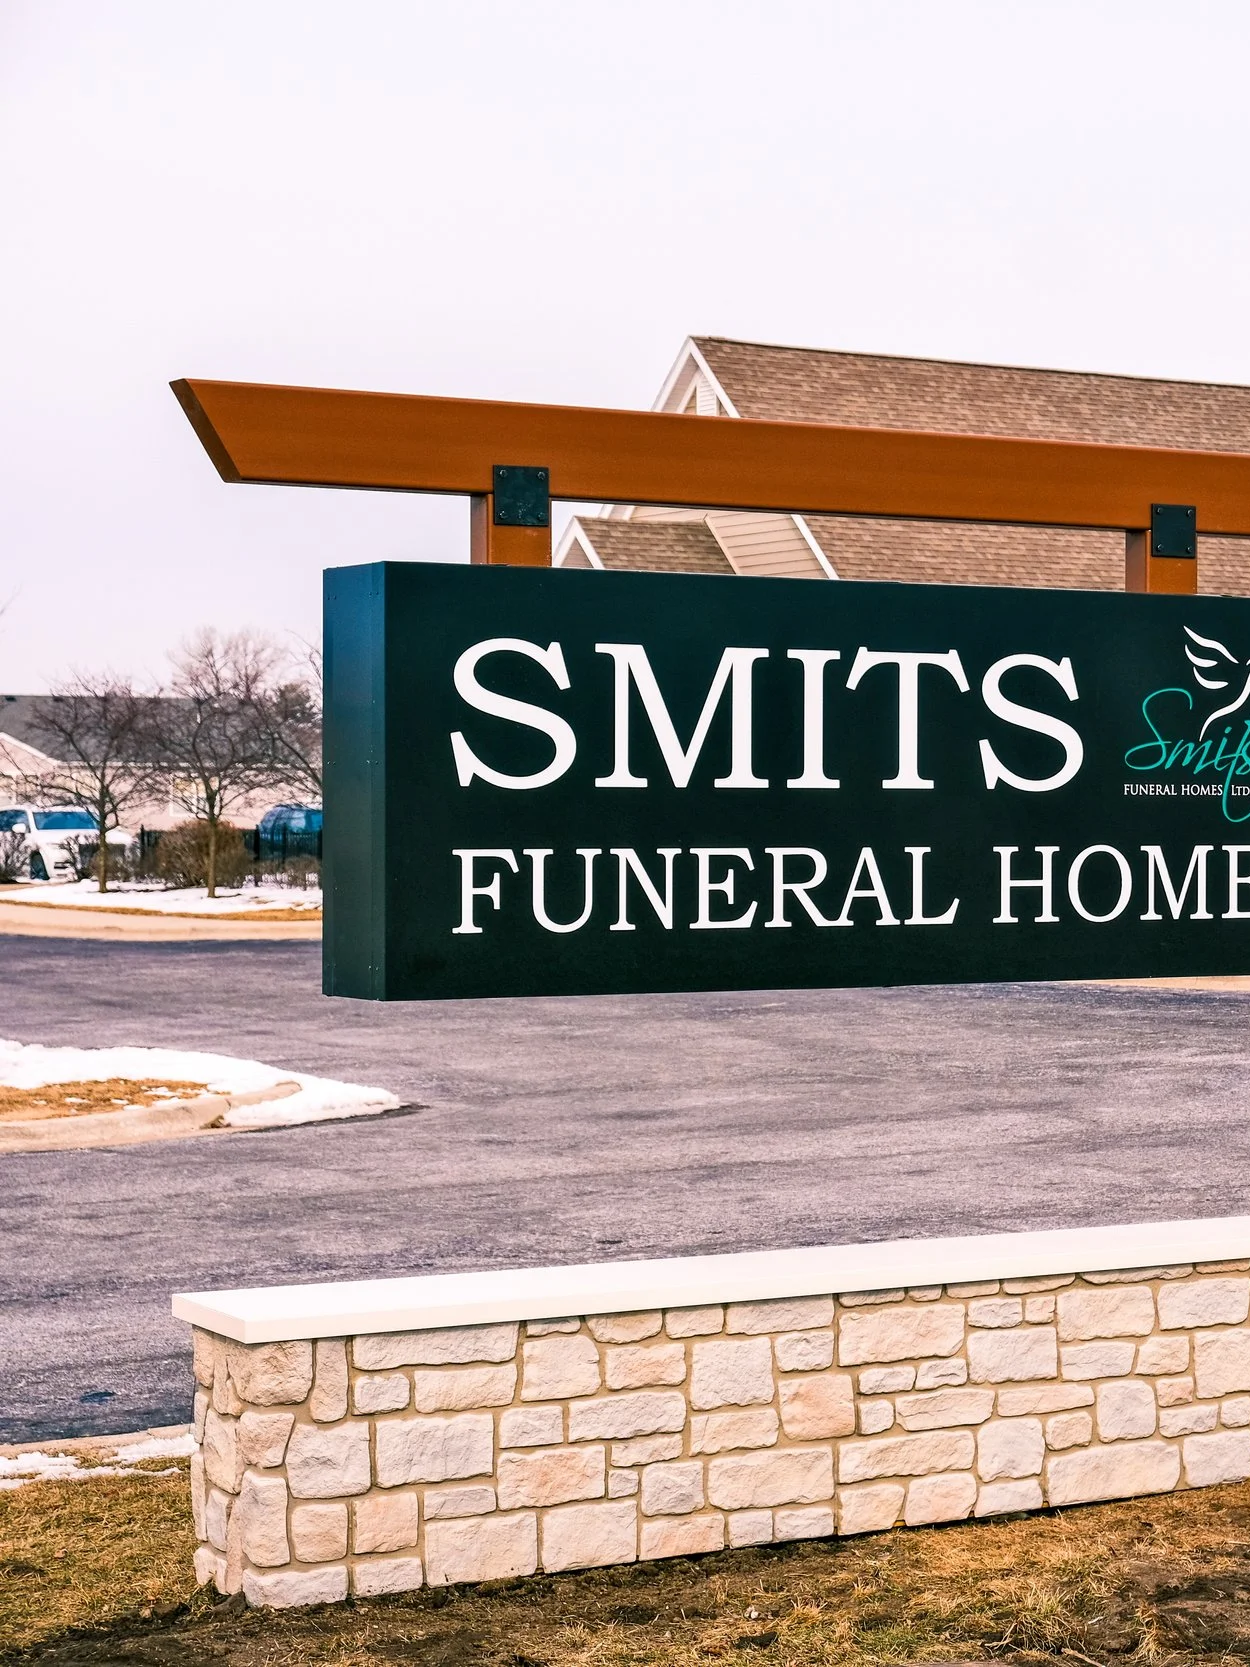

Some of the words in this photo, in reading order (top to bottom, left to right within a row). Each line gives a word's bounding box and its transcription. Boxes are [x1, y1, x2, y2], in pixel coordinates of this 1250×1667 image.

[450, 637, 1084, 793] SMITS
[1123, 783, 1178, 796] FUNERAL
[1181, 784, 1223, 796] HOMES
[451, 846, 960, 935] FUNERAL
